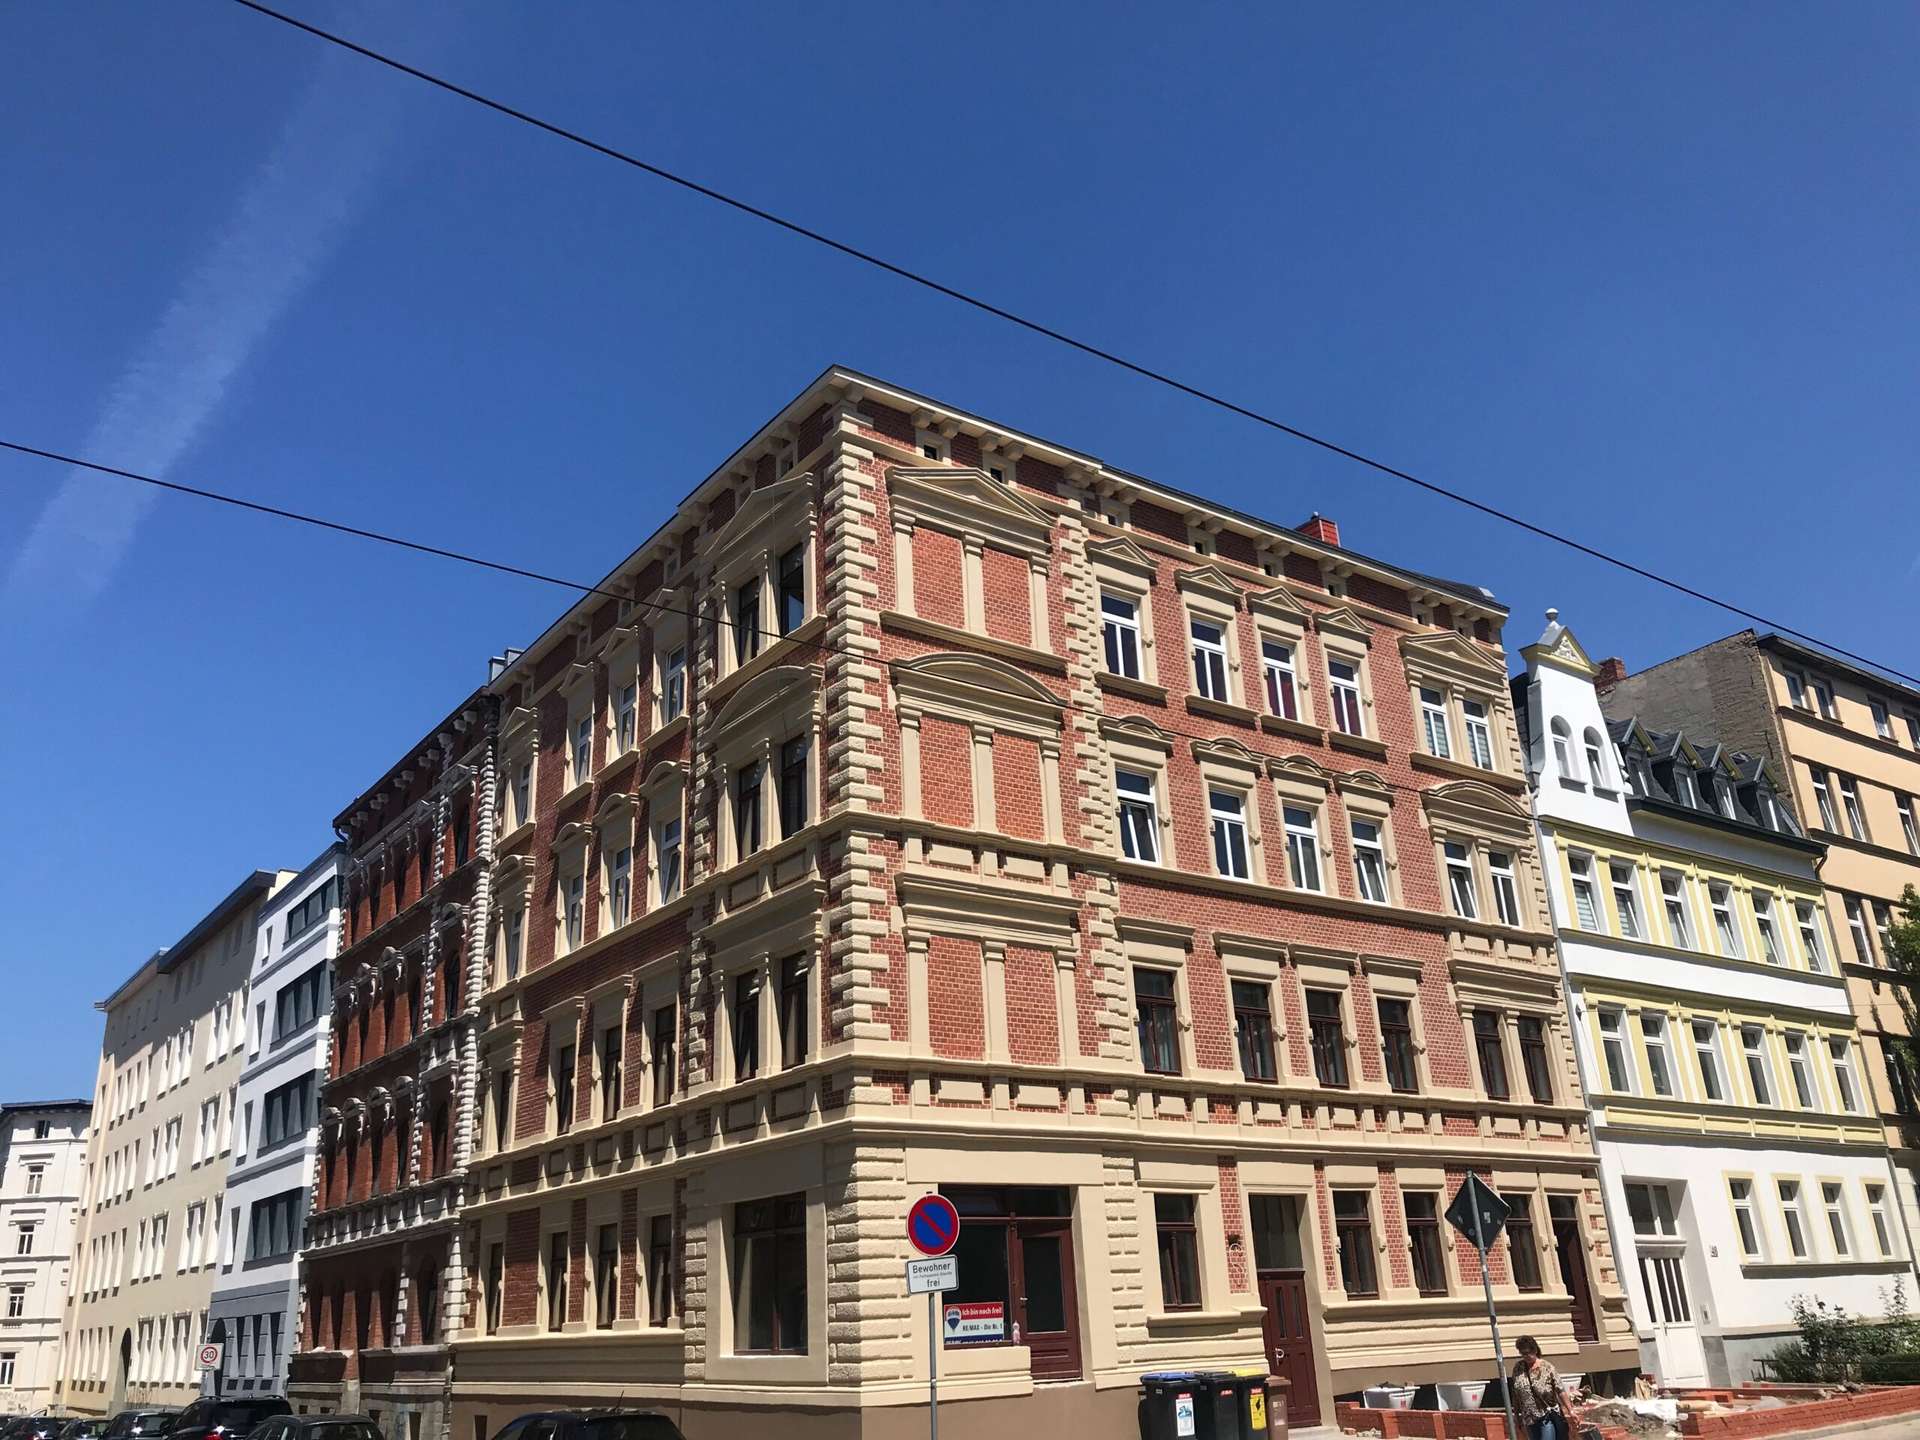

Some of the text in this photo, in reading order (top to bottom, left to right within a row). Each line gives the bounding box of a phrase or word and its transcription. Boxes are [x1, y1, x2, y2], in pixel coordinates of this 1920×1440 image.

[912, 1263, 951, 1273] Bewohner
[927, 1279, 940, 1287] frei
[204, 1350, 214, 1359] 30
